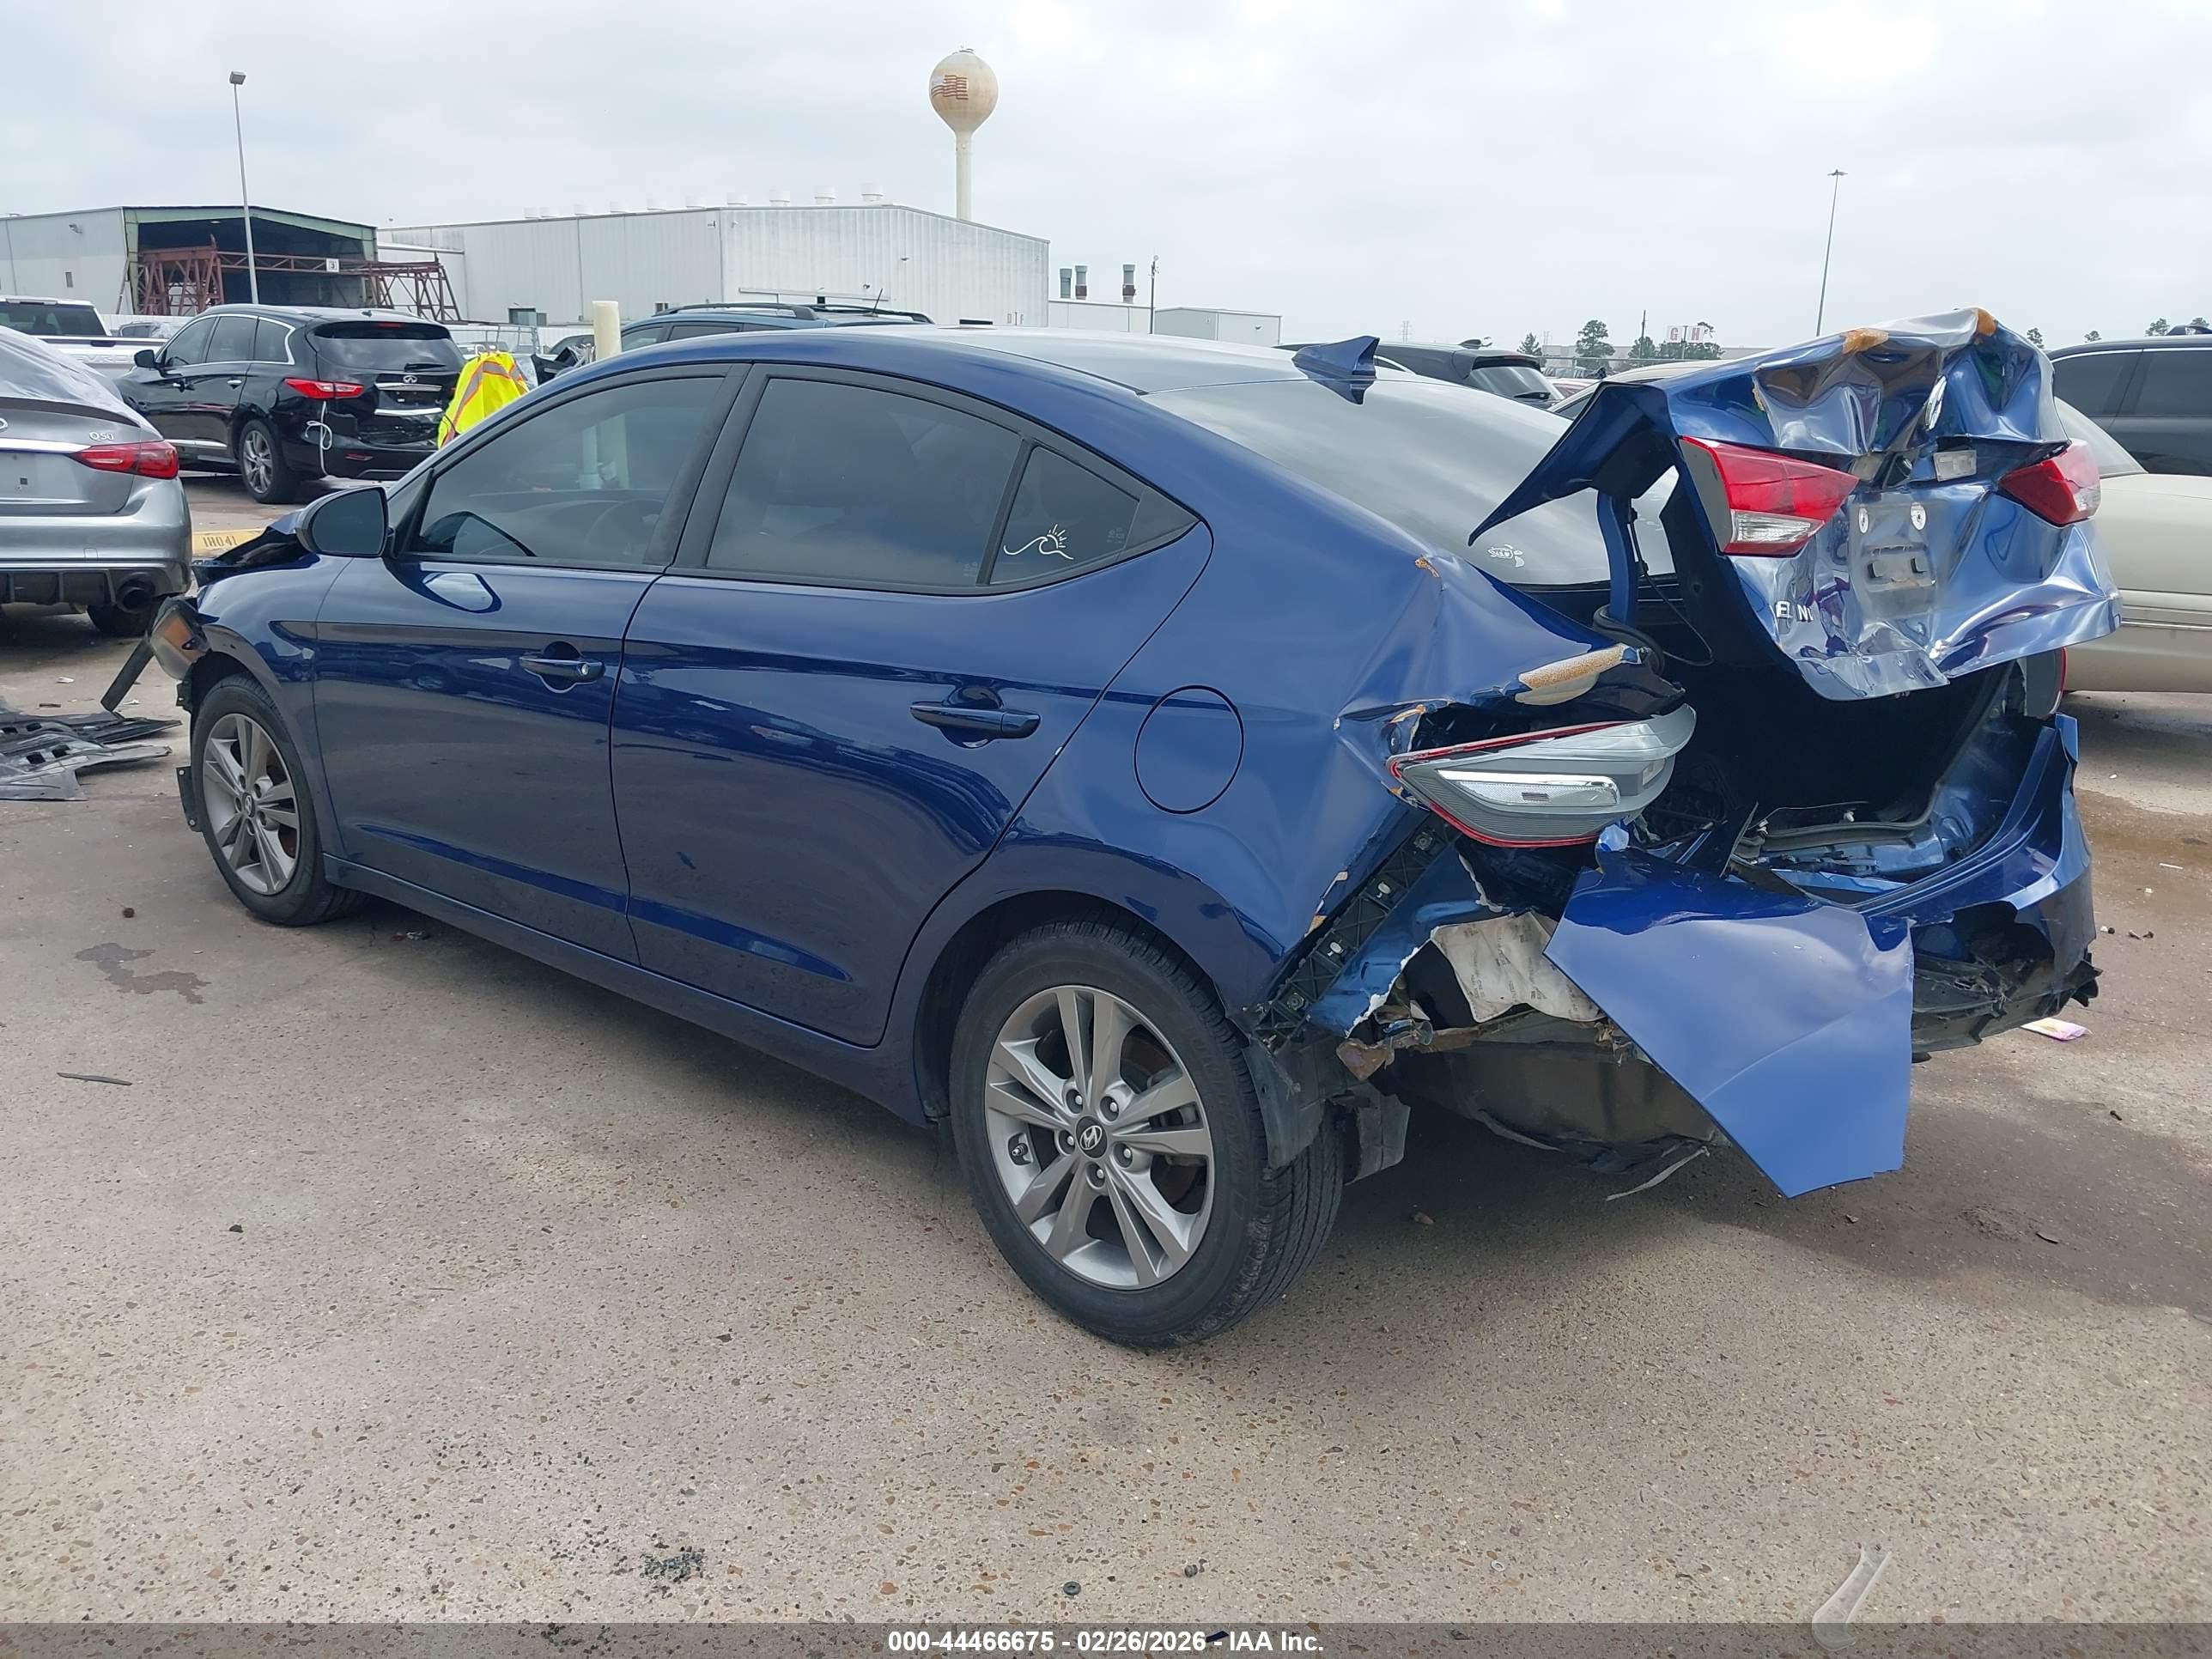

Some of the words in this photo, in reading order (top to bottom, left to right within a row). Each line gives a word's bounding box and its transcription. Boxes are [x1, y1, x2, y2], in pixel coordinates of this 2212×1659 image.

[1670, 327, 1679, 341] G
[1691, 327, 1701, 341] H
[89, 431, 114, 441] Q50
